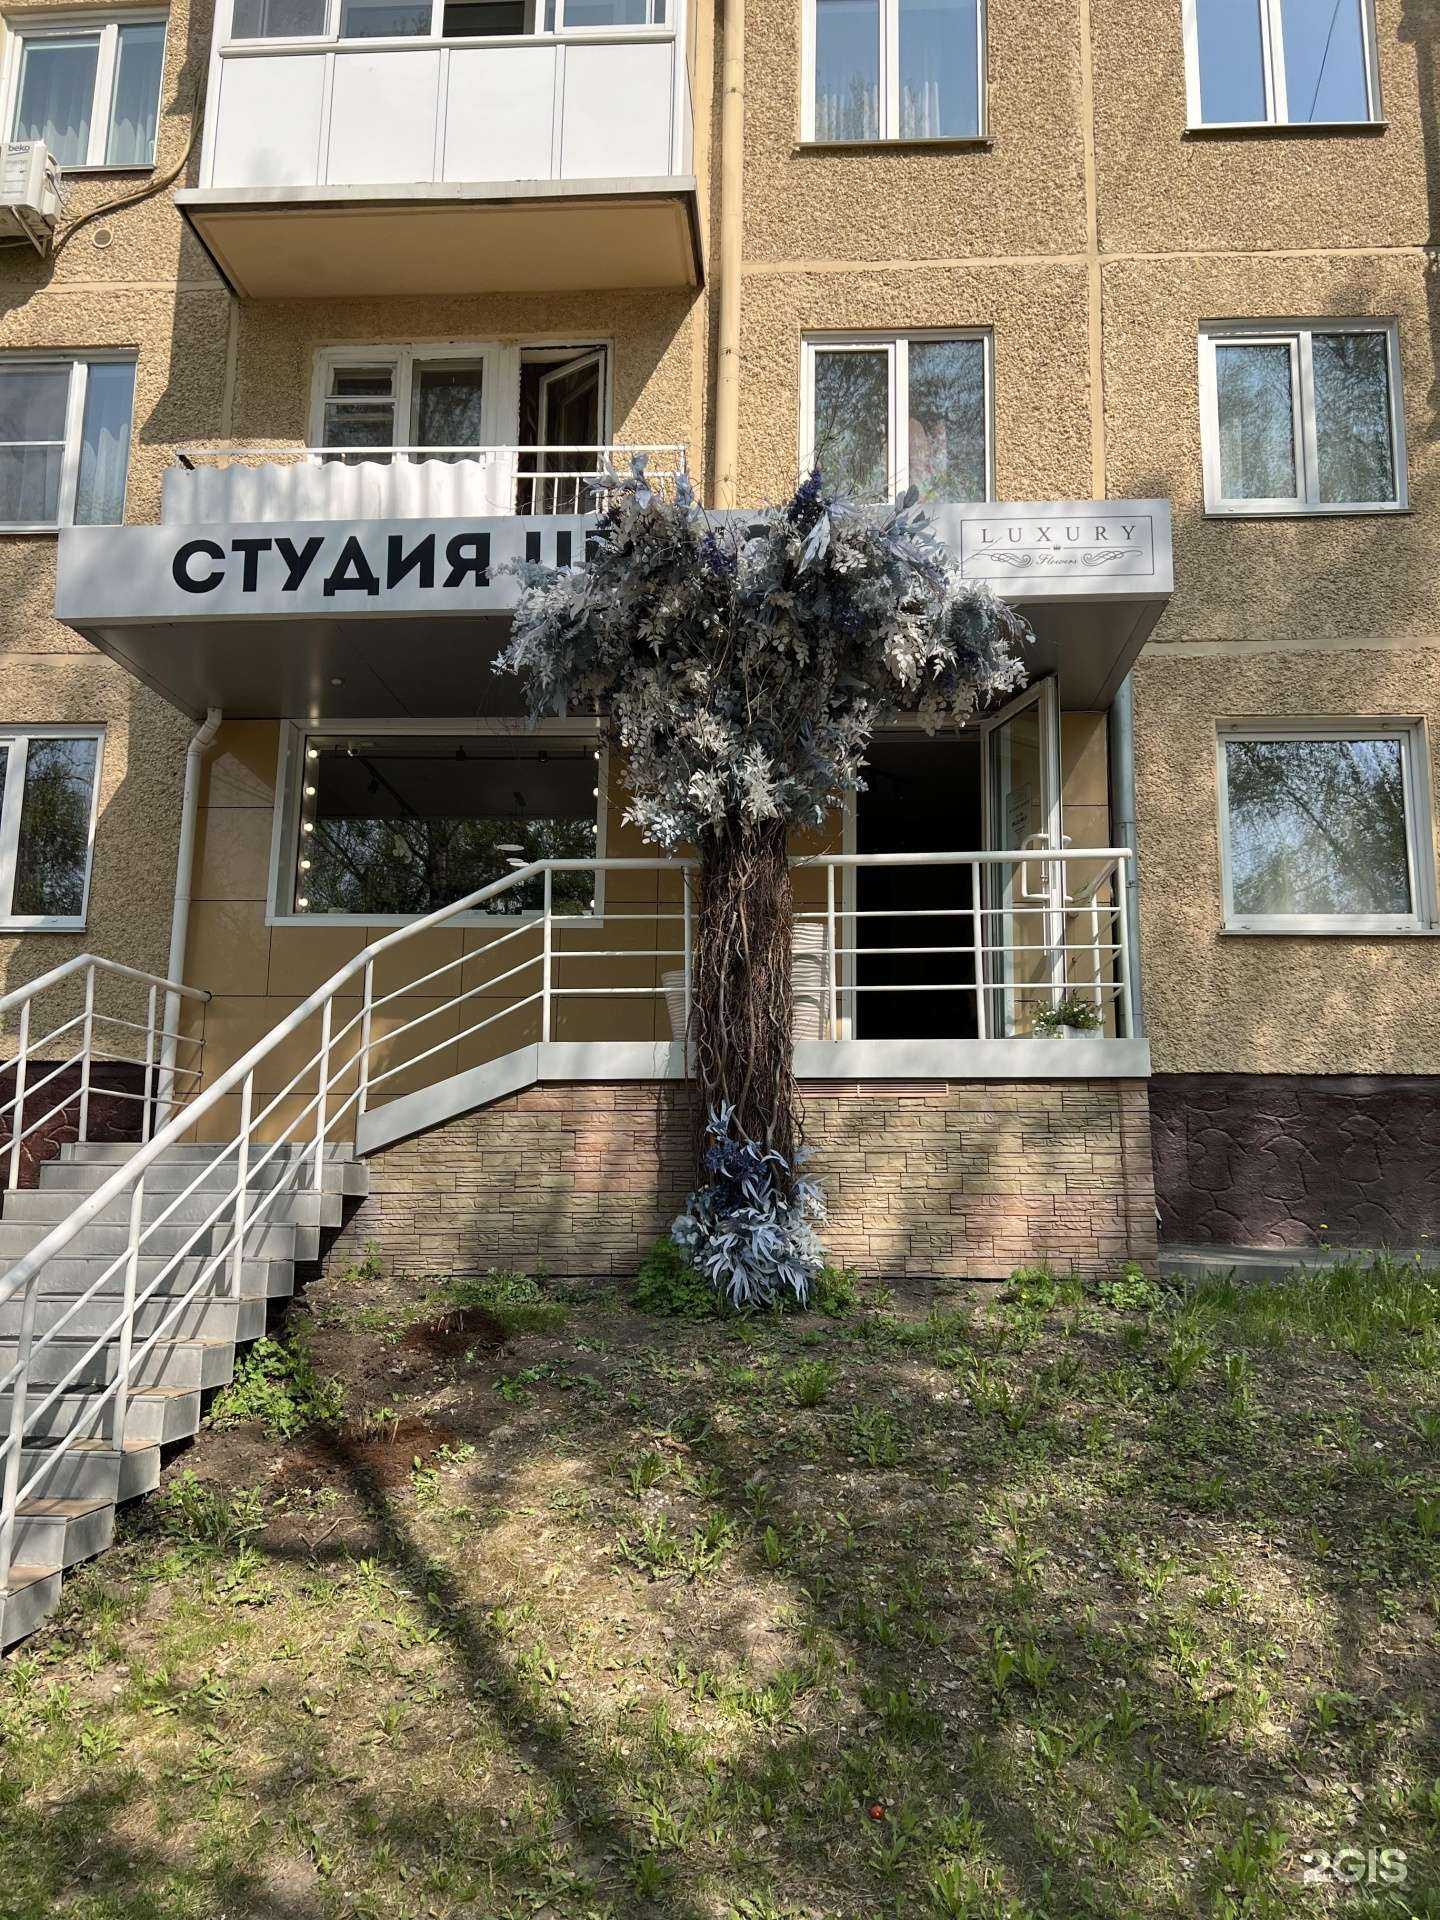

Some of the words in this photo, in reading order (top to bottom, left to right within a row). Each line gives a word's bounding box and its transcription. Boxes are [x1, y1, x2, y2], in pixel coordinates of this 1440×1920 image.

[8, 144, 30, 152] beko
[982, 525, 1136, 543] LUXURY
[172, 532, 491, 596] СТУДИЯ
[1035, 553, 1078, 566] Flowers
